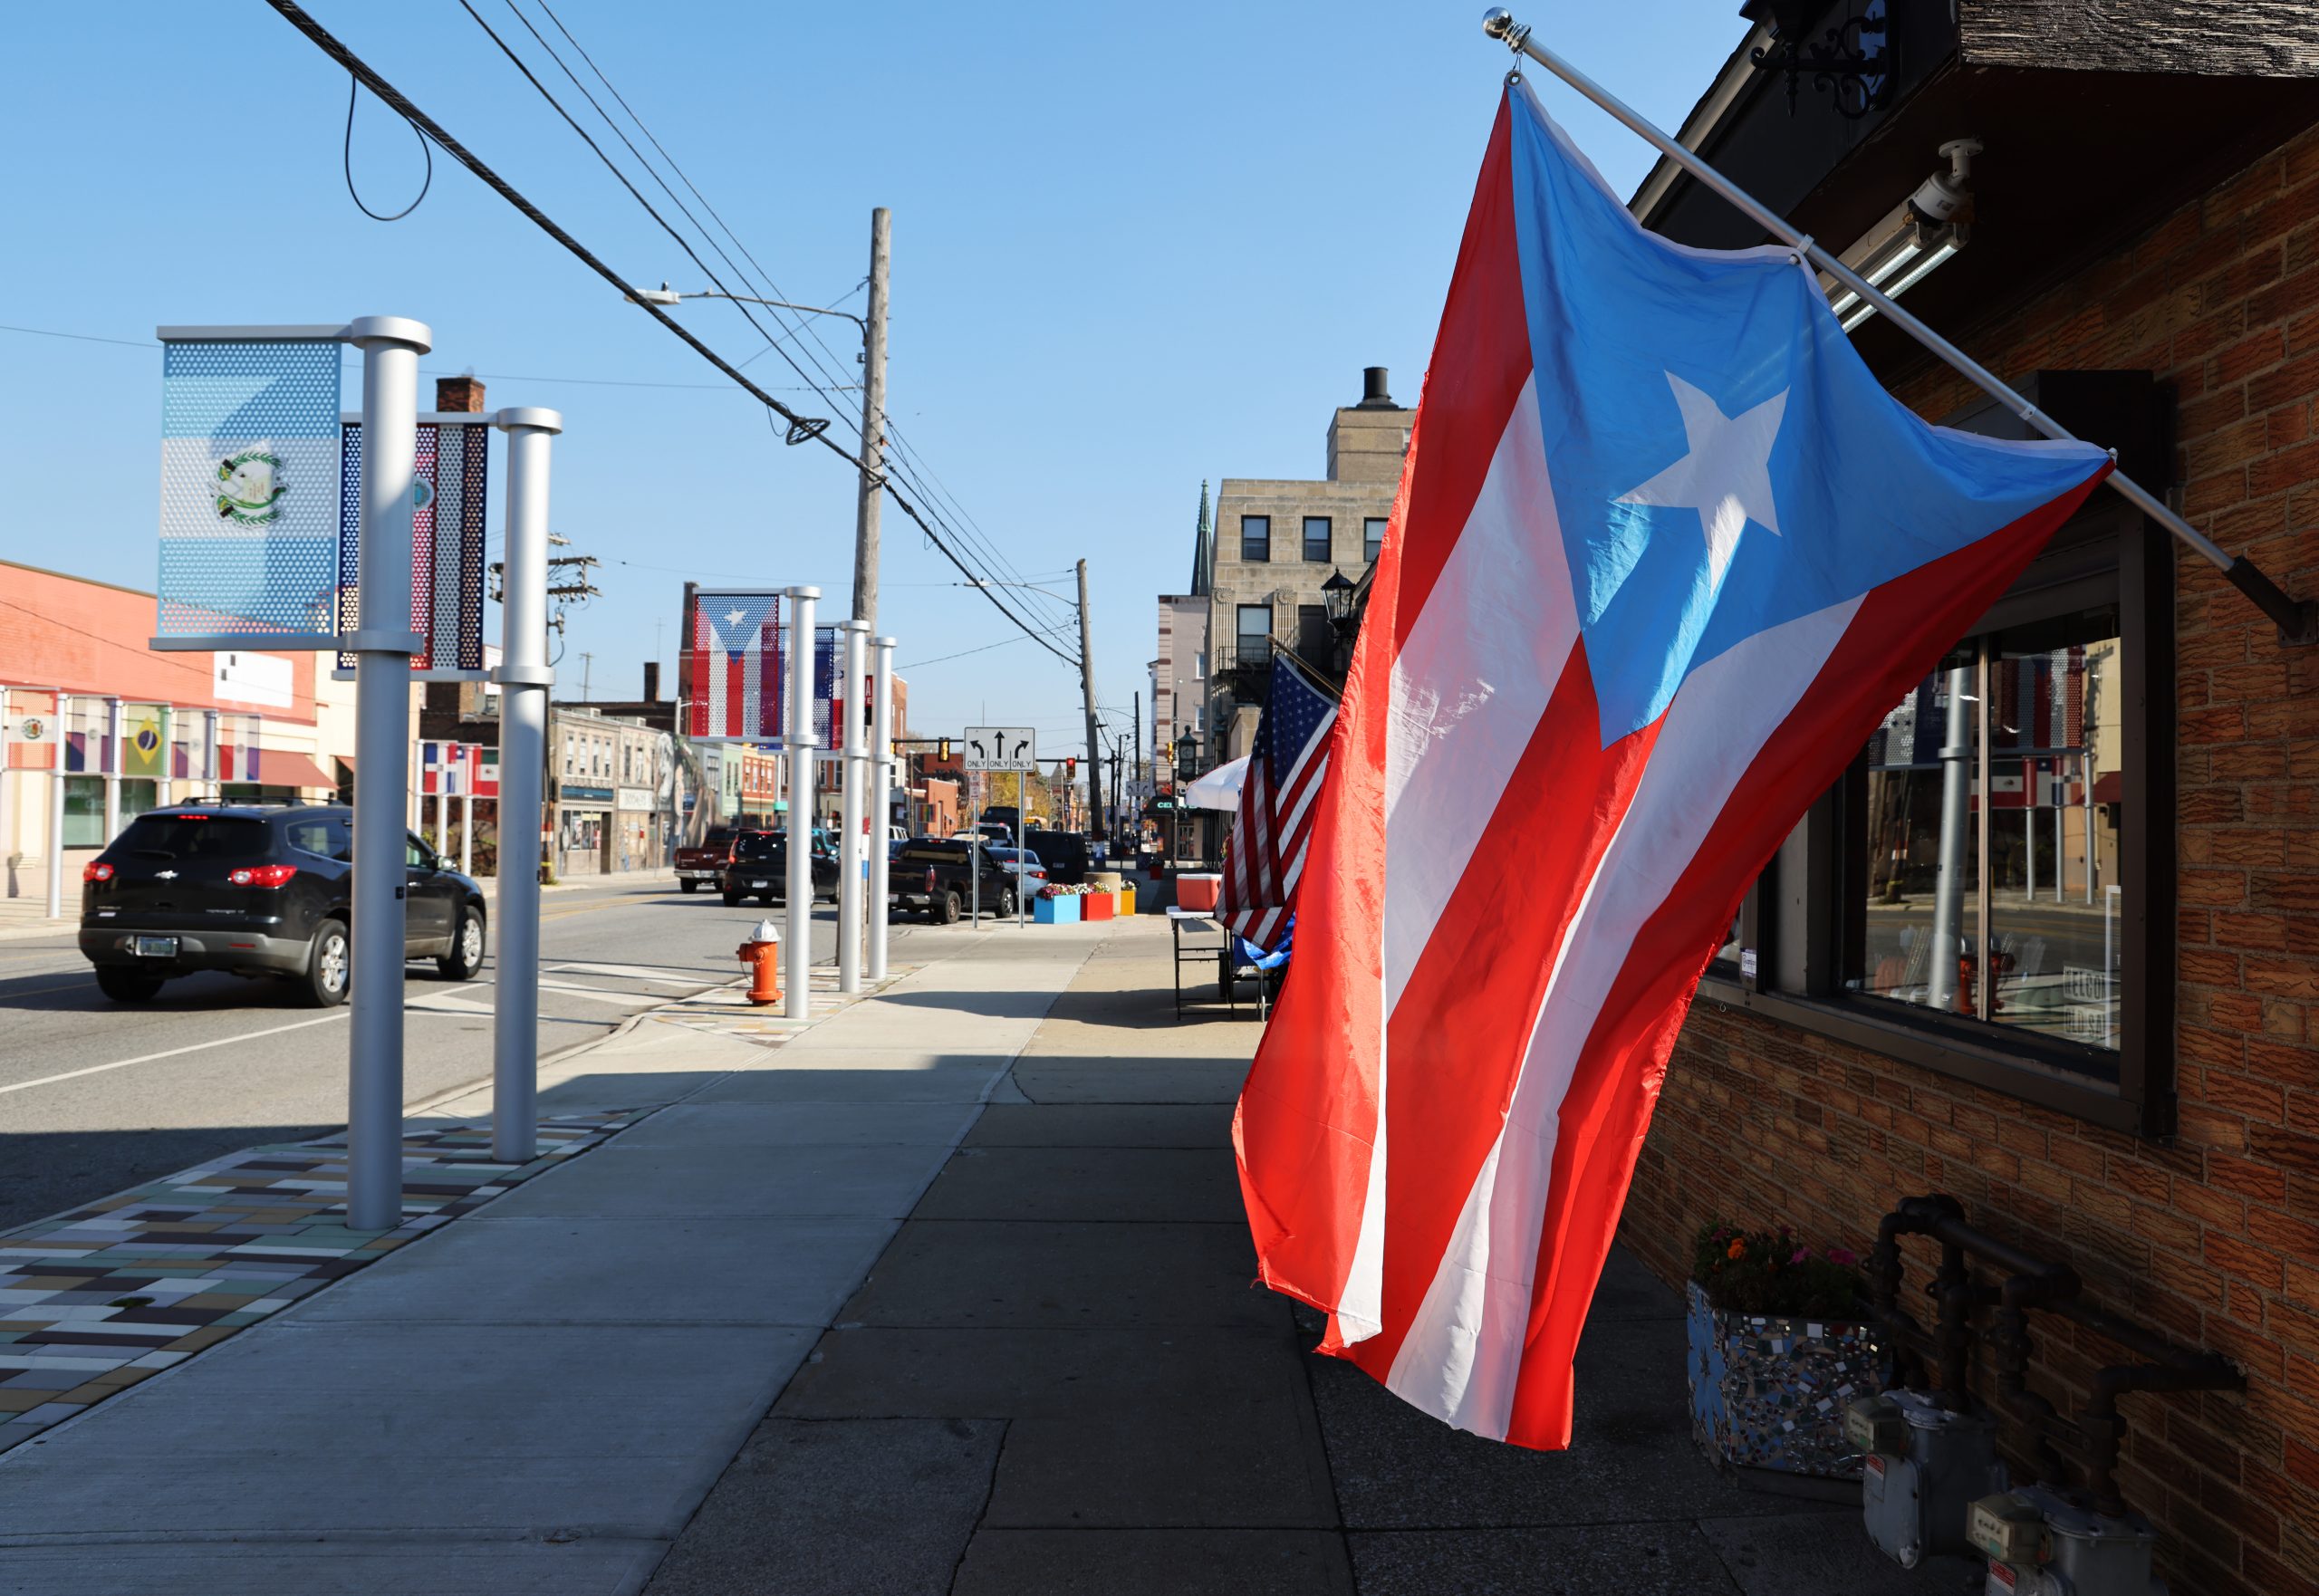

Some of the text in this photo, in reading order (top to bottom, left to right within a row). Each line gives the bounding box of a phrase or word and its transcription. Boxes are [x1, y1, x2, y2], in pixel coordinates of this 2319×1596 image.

[967, 760, 1032, 768] ONLY ONLY ONLY
